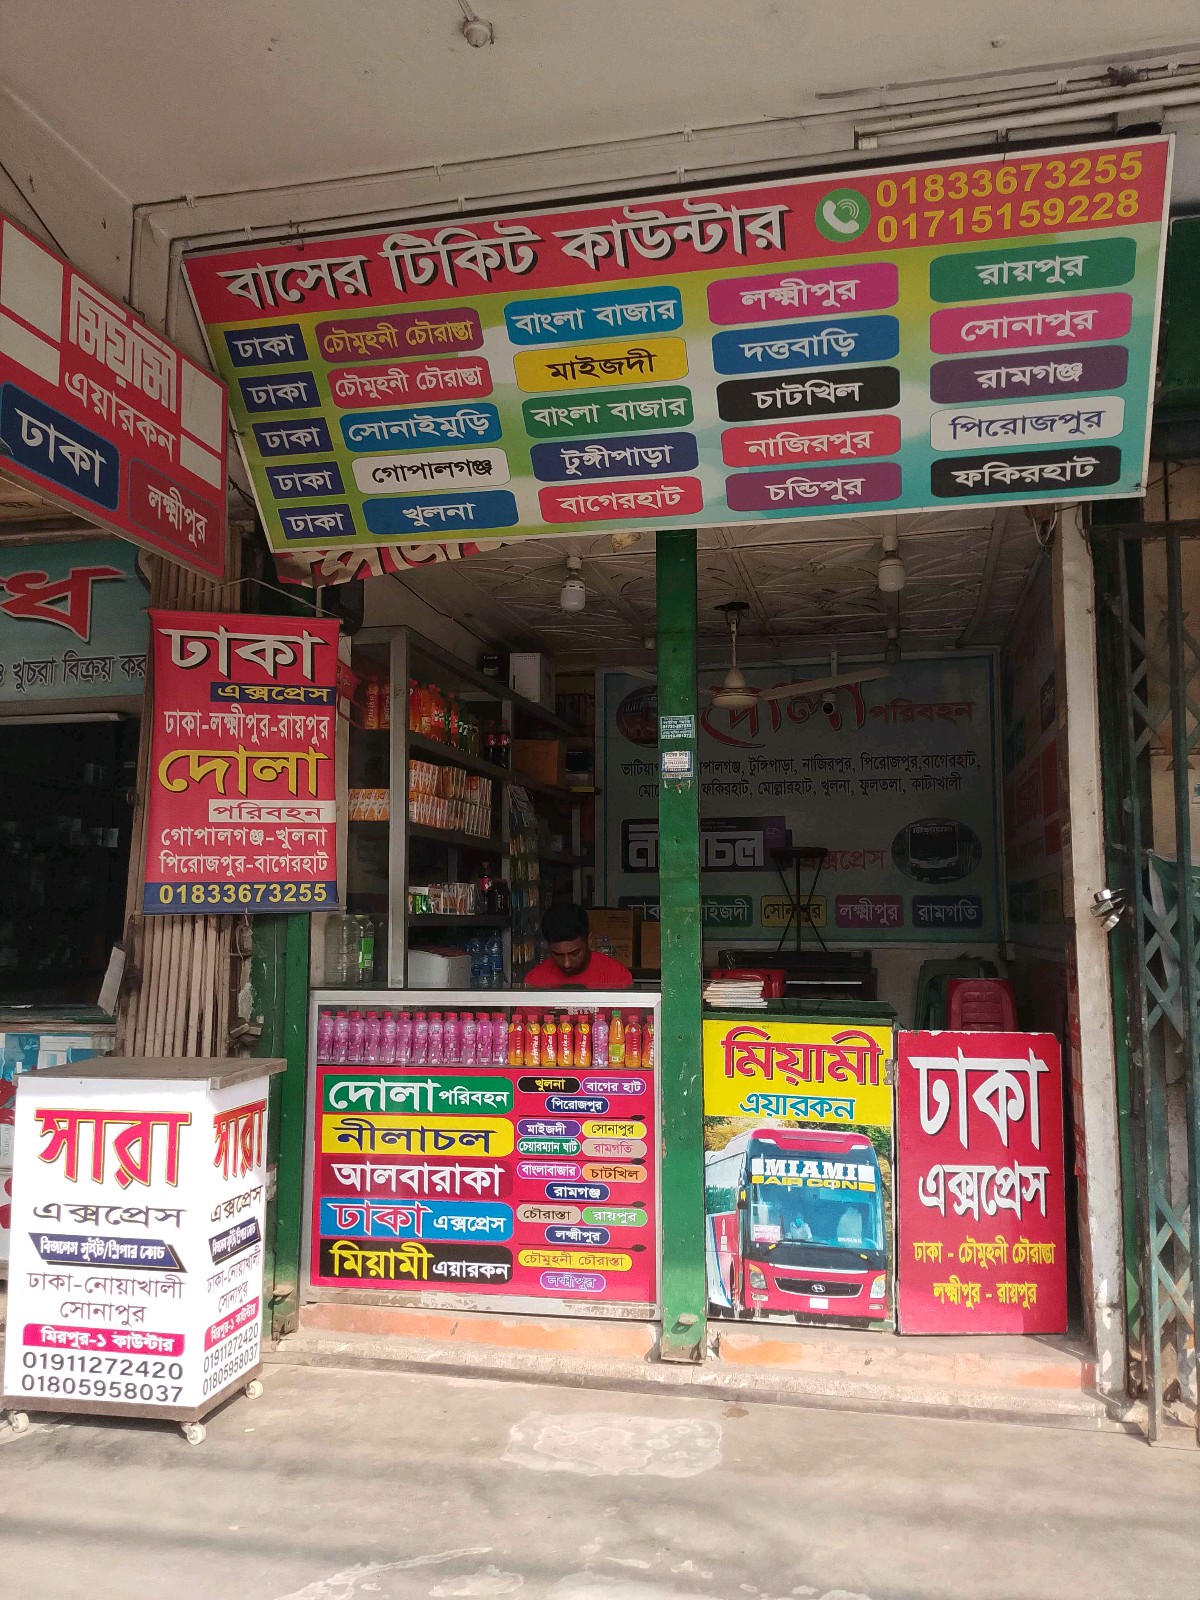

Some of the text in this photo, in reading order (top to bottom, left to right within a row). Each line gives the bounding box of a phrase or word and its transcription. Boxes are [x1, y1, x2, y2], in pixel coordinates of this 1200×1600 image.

[876, 150, 1143, 207] 01833673255
[877, 190, 1140, 243] 01715159228
[219, 198, 790, 308] বাসের টিকিট কাউন্টার
[976, 254, 1089, 286] রায়পুর
[739, 276, 861, 316] লক্ষ্মীপুর
[512, 298, 678, 335] বাংলা বাজার
[960, 308, 1099, 342] সোনাপুর
[69, 273, 178, 416] মিয়ামী
[233, 332, 296, 359] ঢাকা
[324, 318, 474, 356] চৌমুহনী চৌরাস্তা
[739, 327, 859, 363] দত্তবাড়ি
[547, 347, 655, 383] মাইজদী
[975, 359, 1084, 391] রামগঞ্জ
[246, 379, 309, 406] ঢাকা
[336, 364, 484, 402] চৌমুহনী চৌরাস্তা
[751, 378, 865, 410] চাটখিল
[64, 370, 177, 463] এয়ারকন
[530, 395, 689, 430] বাংলা বাজার
[949, 406, 1107, 442] পিরোজপুর
[260, 424, 322, 451] ঢাকা
[348, 411, 492, 446] সোনাইমুড়ি
[15, 407, 107, 488] ঢাকা
[559, 440, 676, 476] টুঙ্গীপাড়া
[744, 429, 875, 460] নাজিরপুর
[274, 471, 334, 496] ঢাকা
[371, 457, 494, 486] গোপালগঞ্জ
[950, 455, 1101, 488] ফকিরহাট
[147, 482, 208, 549] লক্ষ্মীপুর
[402, 500, 477, 526] খুলনা
[557, 485, 687, 516] বাগেরহাট
[286, 511, 345, 536] ঢাকা
[157, 625, 327, 681] ঢাকা
[12, 656, 57, 693] খুচরা
[61, 649, 116, 685] বিক্রয়
[217, 685, 332, 703] এক্সপ্রেস
[870, 697, 976, 726] পরিবহন
[158, 744, 331, 797] দোলা
[802, 755, 856, 775] নাজিরপুর,
[821, 778, 854, 798] খুলনা,
[911, 773, 963, 793] কাটাখালী
[213, 803, 325, 823] পরিবহন
[161, 827, 328, 850] গোপালগঞ্জ-খুলনা
[159, 850, 329, 878] পিরোজপুর-বাগেরহাট
[159, 883, 328, 904] 01833673255
[702, 898, 750, 922] াইজদী
[916, 896, 980, 922] রামগতি
[722, 1025, 883, 1086] মিয়ামী
[329, 1077, 510, 1113] দোলা পরিবহন
[535, 1078, 566, 1093] খুলনা
[586, 1080, 643, 1093] বাগের হাট
[907, 1046, 1050, 1150] ঢাকা
[551, 1097, 603, 1112] পিরোজপুর
[739, 1092, 855, 1120] এয়ারকন
[213, 1098, 267, 1181] সারা
[332, 1118, 500, 1154] নীলাচল
[526, 1122, 567, 1136] মাইজদী
[591, 1122, 635, 1137] সোনাপুর
[34, 1107, 192, 1190] সারা
[518, 1139, 579, 1153] চেয়ারম্যান ঘাট
[593, 1140, 634, 1154] রামগতি
[332, 1160, 505, 1197] আলবারাকা
[522, 1163, 577, 1178] বাংলাবাজার
[590, 1167, 641, 1181] চাটখিল
[765, 1159, 858, 1181] MIAMI
[806, 1179, 858, 1190] CON
[211, 1185, 264, 1223] এক্সপ্রেস
[553, 1184, 602, 1199] রামগঞ্জ
[919, 1159, 1050, 1221] এক্সপ্রেস
[33, 1202, 187, 1228] এক্সপ্রেস
[329, 1200, 506, 1237] ঢাকা এক্সপ্রেস
[523, 1206, 572, 1221] চৌরাস্তা
[592, 1210, 637, 1225] রায়পুর
[139, 1245, 166, 1260] কোচ
[329, 1240, 510, 1281] মিয়ামী এয়ারকন
[524, 1250, 626, 1268] চৌমুহনী চৌরাস্তা
[913, 1240, 944, 1266] ঢাকা
[958, 1235, 1008, 1270] চৌমুহনী
[1011, 1235, 1056, 1265] চৌরাস্তা
[27, 1271, 187, 1301] ঢাকা-নোয়াখালী
[218, 1279, 249, 1313] সোনাপুর
[996, 1281, 1038, 1311] রায়পুর
[60, 1300, 147, 1326] সোনাপুর
[235, 1303, 257, 1327] কাউন্টার
[40, 1325, 175, 1353] মিরপুর-১ কাউন্টার
[203, 1321, 260, 1374] 01911272420
[22, 1351, 184, 1381] 01911272420
[202, 1342, 260, 1397] 01805958037
[20, 1373, 184, 1403] 01805958037
